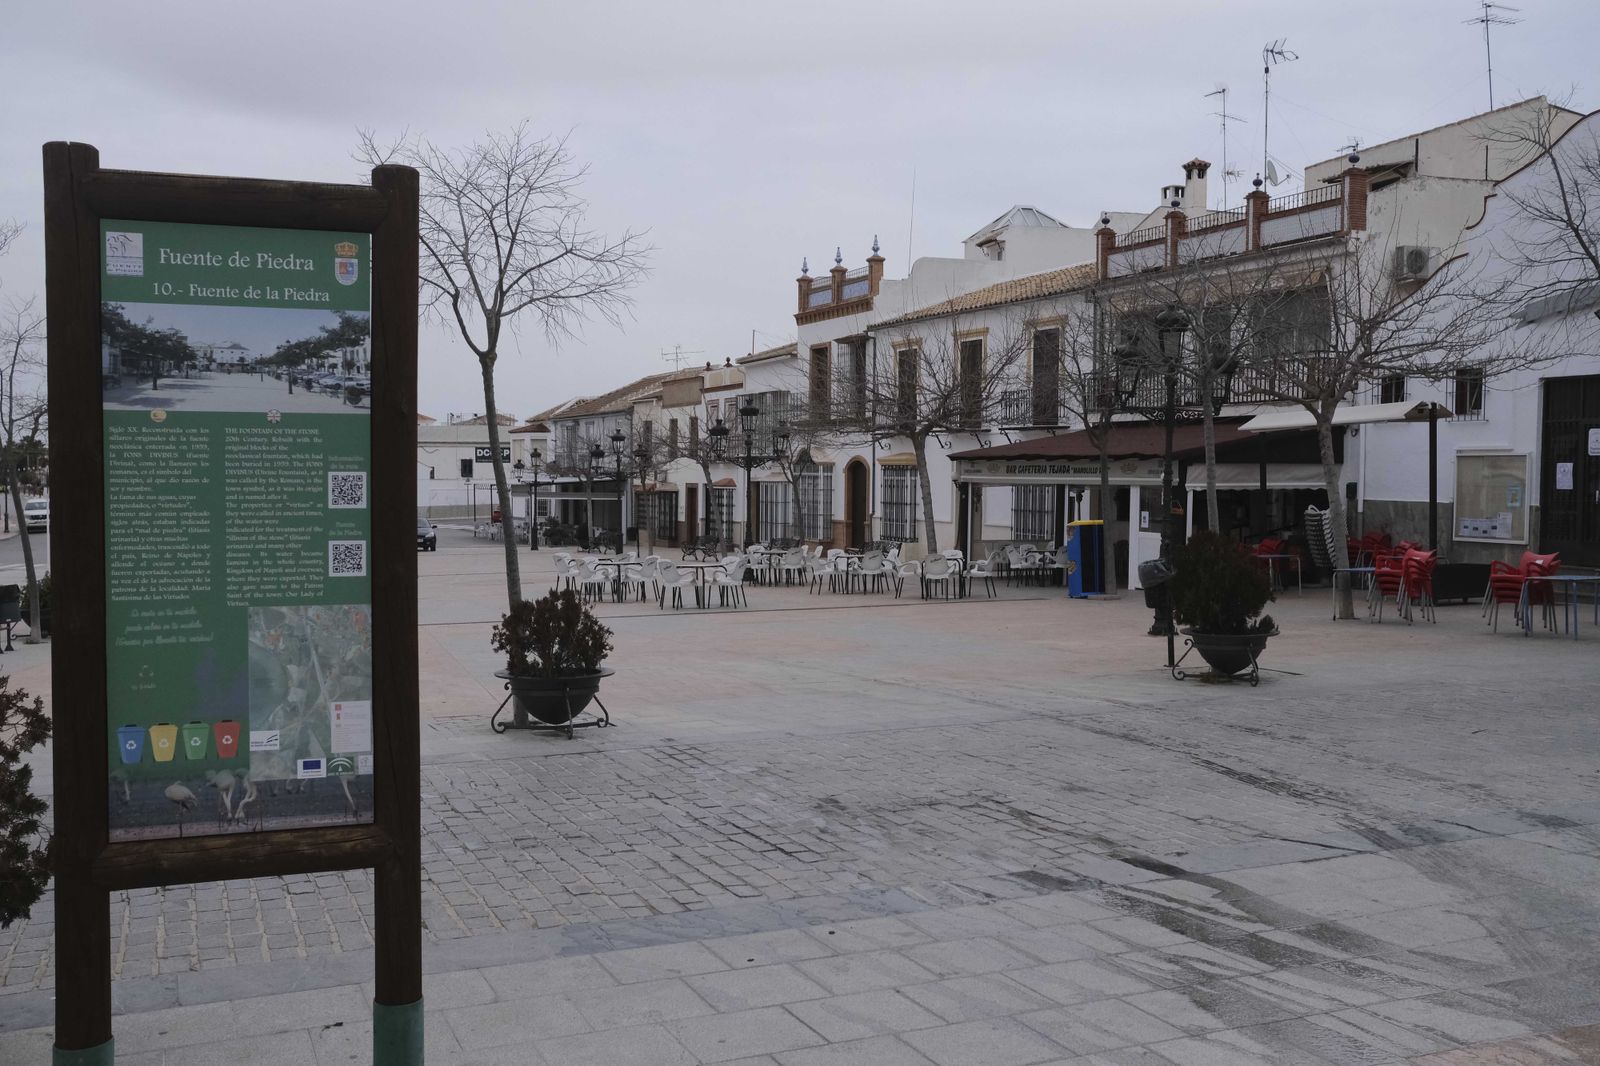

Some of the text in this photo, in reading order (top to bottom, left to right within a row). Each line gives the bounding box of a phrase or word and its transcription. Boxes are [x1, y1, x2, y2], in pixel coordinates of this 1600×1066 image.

[159, 248, 315, 271] Fuente de Piedra
[153, 282, 331, 302] 10.- Fuente de la Piedra
[1006, 464, 1017, 474] BAR
[1018, 464, 1048, 474] CAFETERIA
[1048, 464, 1070, 474] TEJADA
